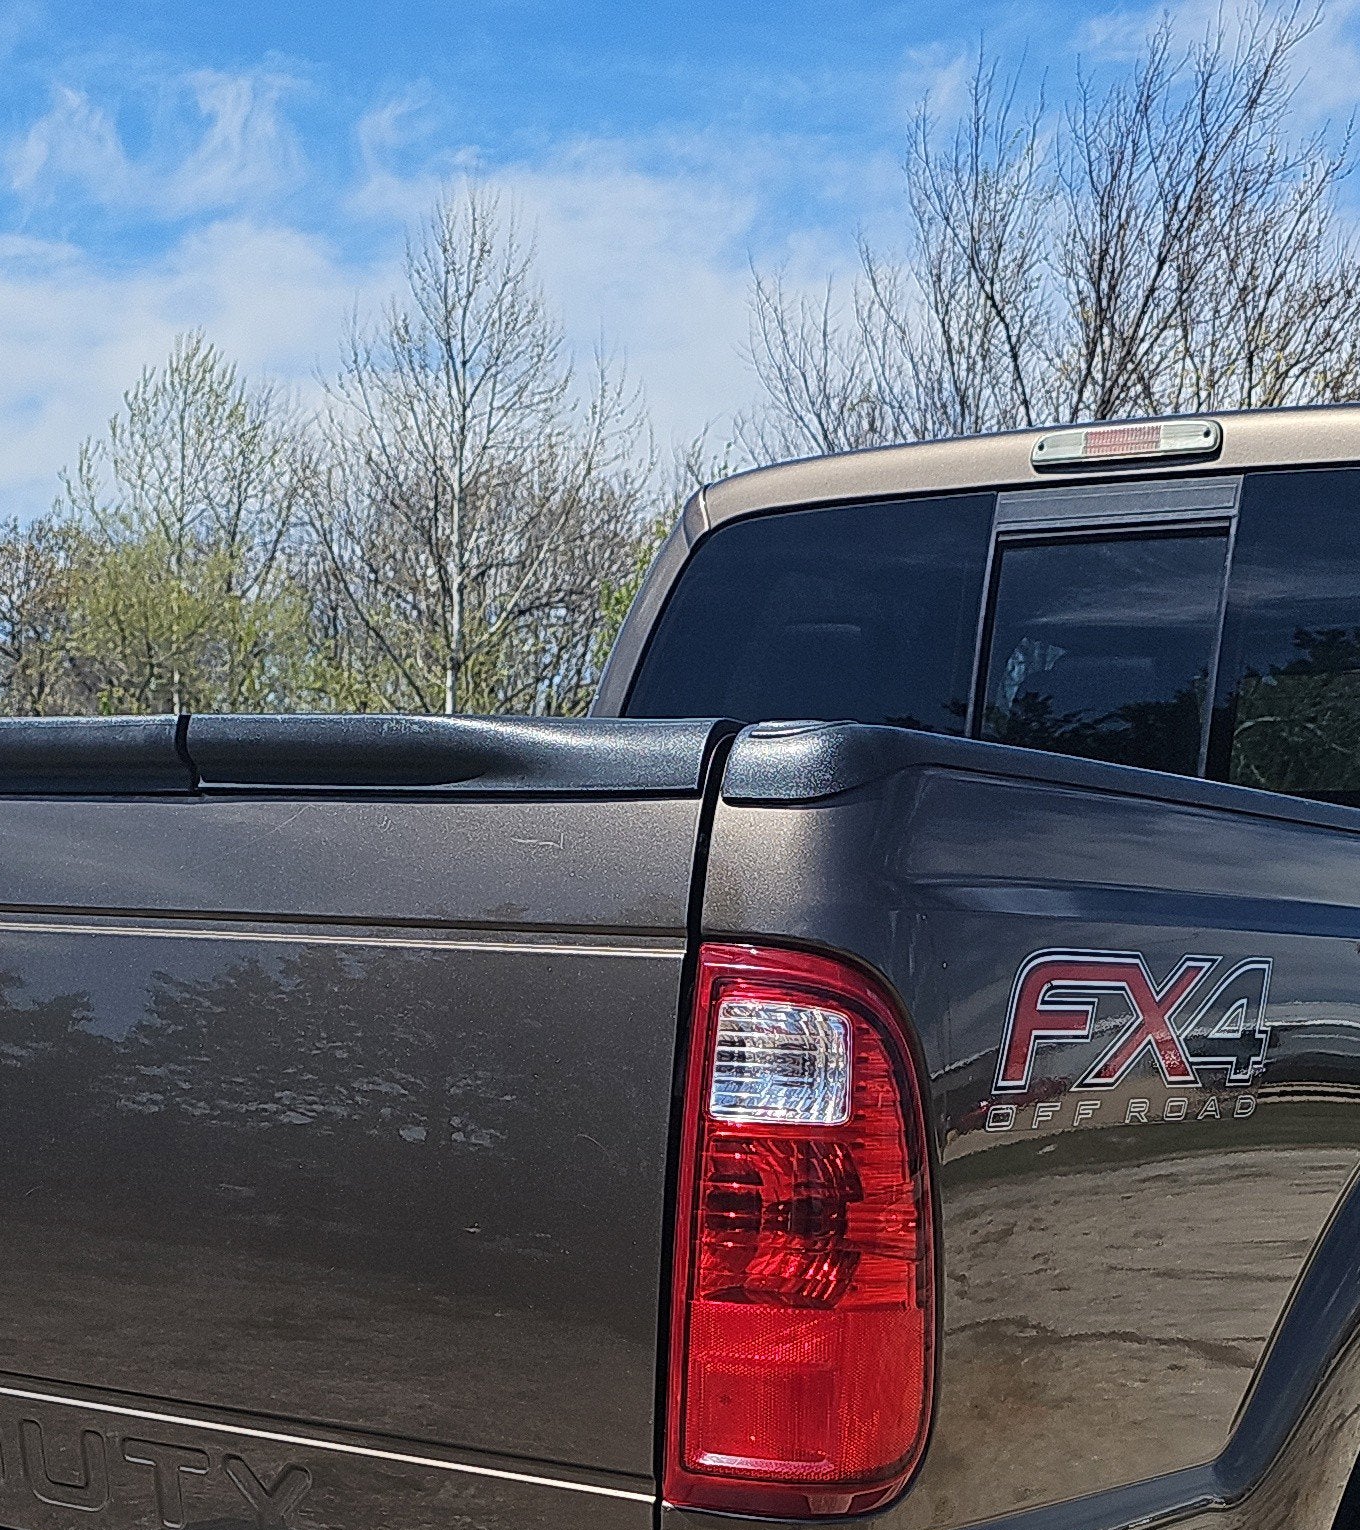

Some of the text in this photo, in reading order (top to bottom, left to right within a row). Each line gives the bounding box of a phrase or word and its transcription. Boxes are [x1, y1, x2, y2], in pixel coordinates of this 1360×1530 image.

[991, 948, 1273, 1094] FX4
[985, 1094, 1259, 1132] OFF ROAD
